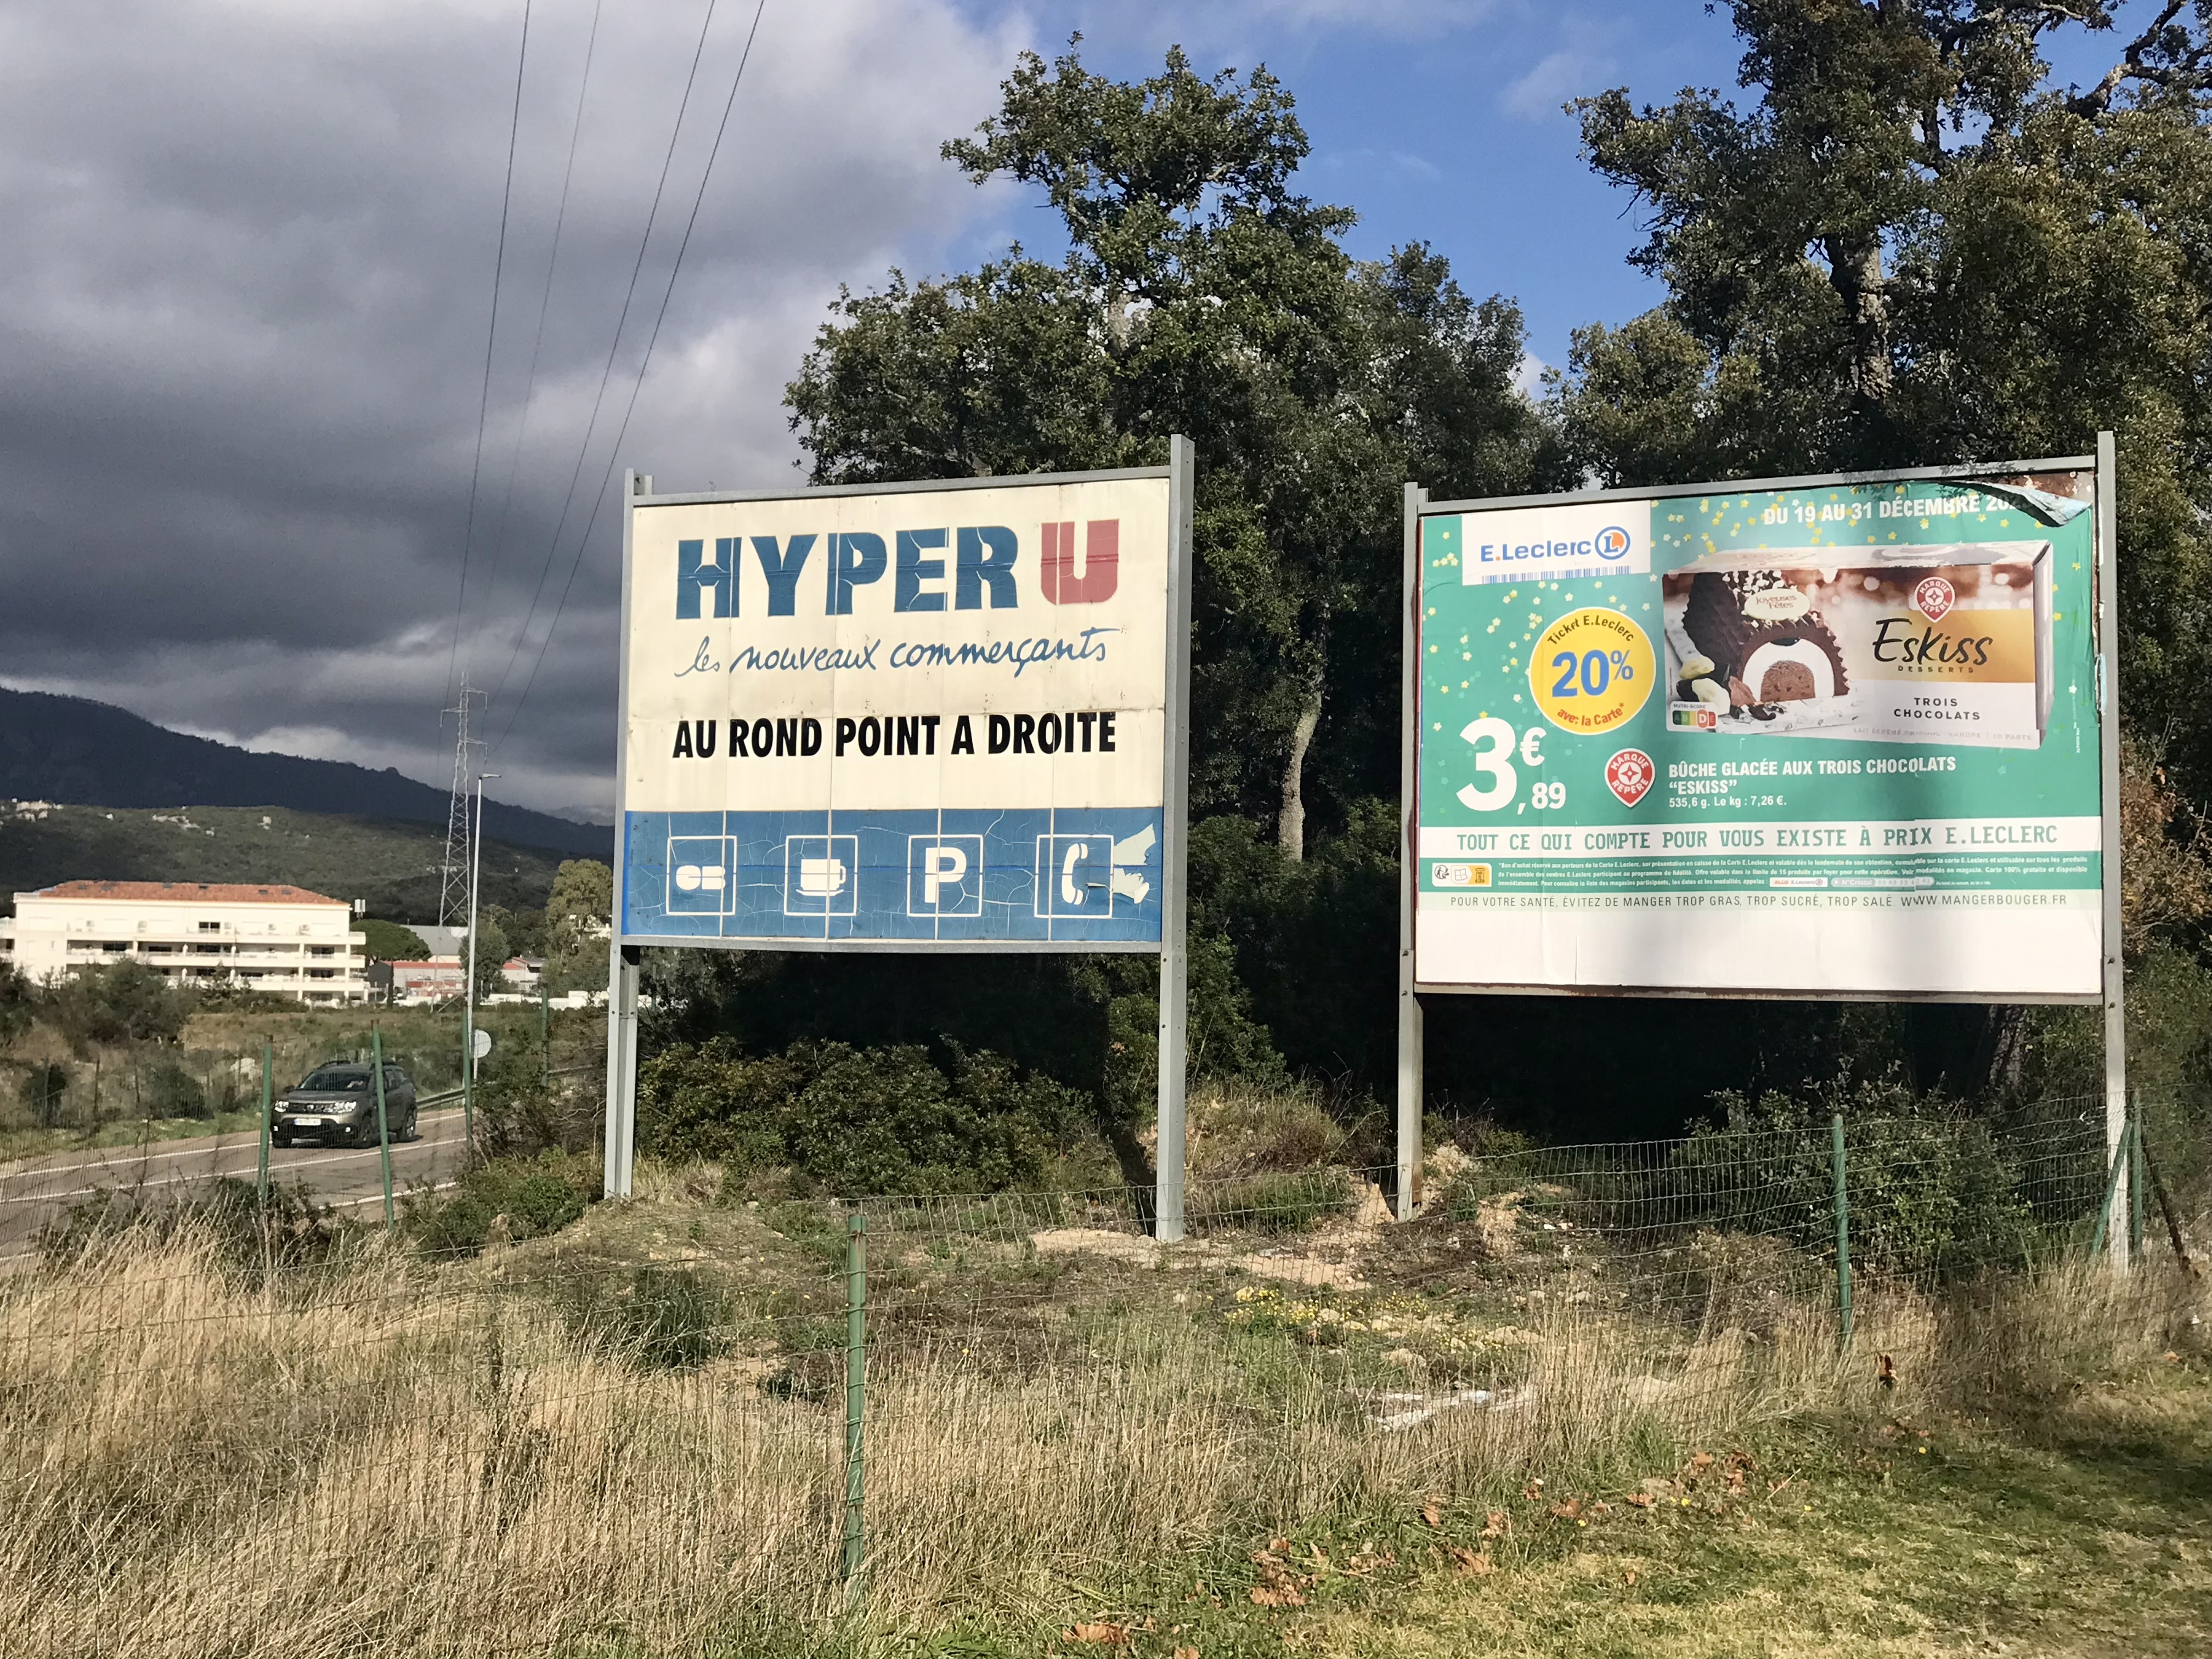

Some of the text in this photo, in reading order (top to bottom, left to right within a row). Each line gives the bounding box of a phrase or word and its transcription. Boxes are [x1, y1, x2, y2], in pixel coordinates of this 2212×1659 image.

[1764, 507, 1788, 525] DU
[1795, 506, 1815, 523] 19
[1821, 504, 1846, 522] AU
[1851, 501, 1872, 520] 31
[1880, 494, 1980, 518] DÉCEMBRE
[1481, 540, 1592, 562] E.Leclerc
[675, 518, 1121, 620] HYPER U
[1920, 581, 1950, 594] MARQUE
[1583, 615, 1634, 642] E.Leclerc
[1872, 618, 1993, 665] Eskiss
[674, 627, 1121, 679] les nouveaux commerçants
[1552, 649, 1634, 698] 20%
[1914, 697, 1958, 707] TROIS
[1581, 715, 1592, 726] la
[1699, 714, 1707, 723] D
[1894, 708, 1981, 720] CHOCOLATS
[672, 711, 1116, 758] AU ROND POINT A DROITE
[1609, 753, 1649, 770] MARQUE
[1669, 756, 1956, 778] BÛCHE GLACÉE AUX TROIS CHOCOLATS
[1669, 797, 1698, 809] 535,6
[1701, 798, 1710, 809] g.
[1714, 796, 1726, 806] Le
[1729, 795, 1741, 808] kg
[1751, 795, 1774, 808] 7,26
[1457, 825, 2057, 850] TOUT CE QUI COMPTE POUR VOUS EXISTE À PRIX E.LECLERC
[923, 847, 967, 904] P
[1451, 897, 1478, 906] POUR
[1482, 897, 1516, 906] VOTRE
[1520, 895, 1558, 908] SANTÉ,
[1563, 895, 1600, 907] ÉVITEZ
[1605, 898, 1618, 906] DE
[1623, 896, 1671, 906] MANGER
[1676, 896, 1705, 906] TROP
[1709, 896, 1742, 906] GRAS,
[1747, 896, 1776, 906] TROP
[1781, 894, 1822, 907] SUCRÉ,
[1827, 896, 1857, 906] TROP
